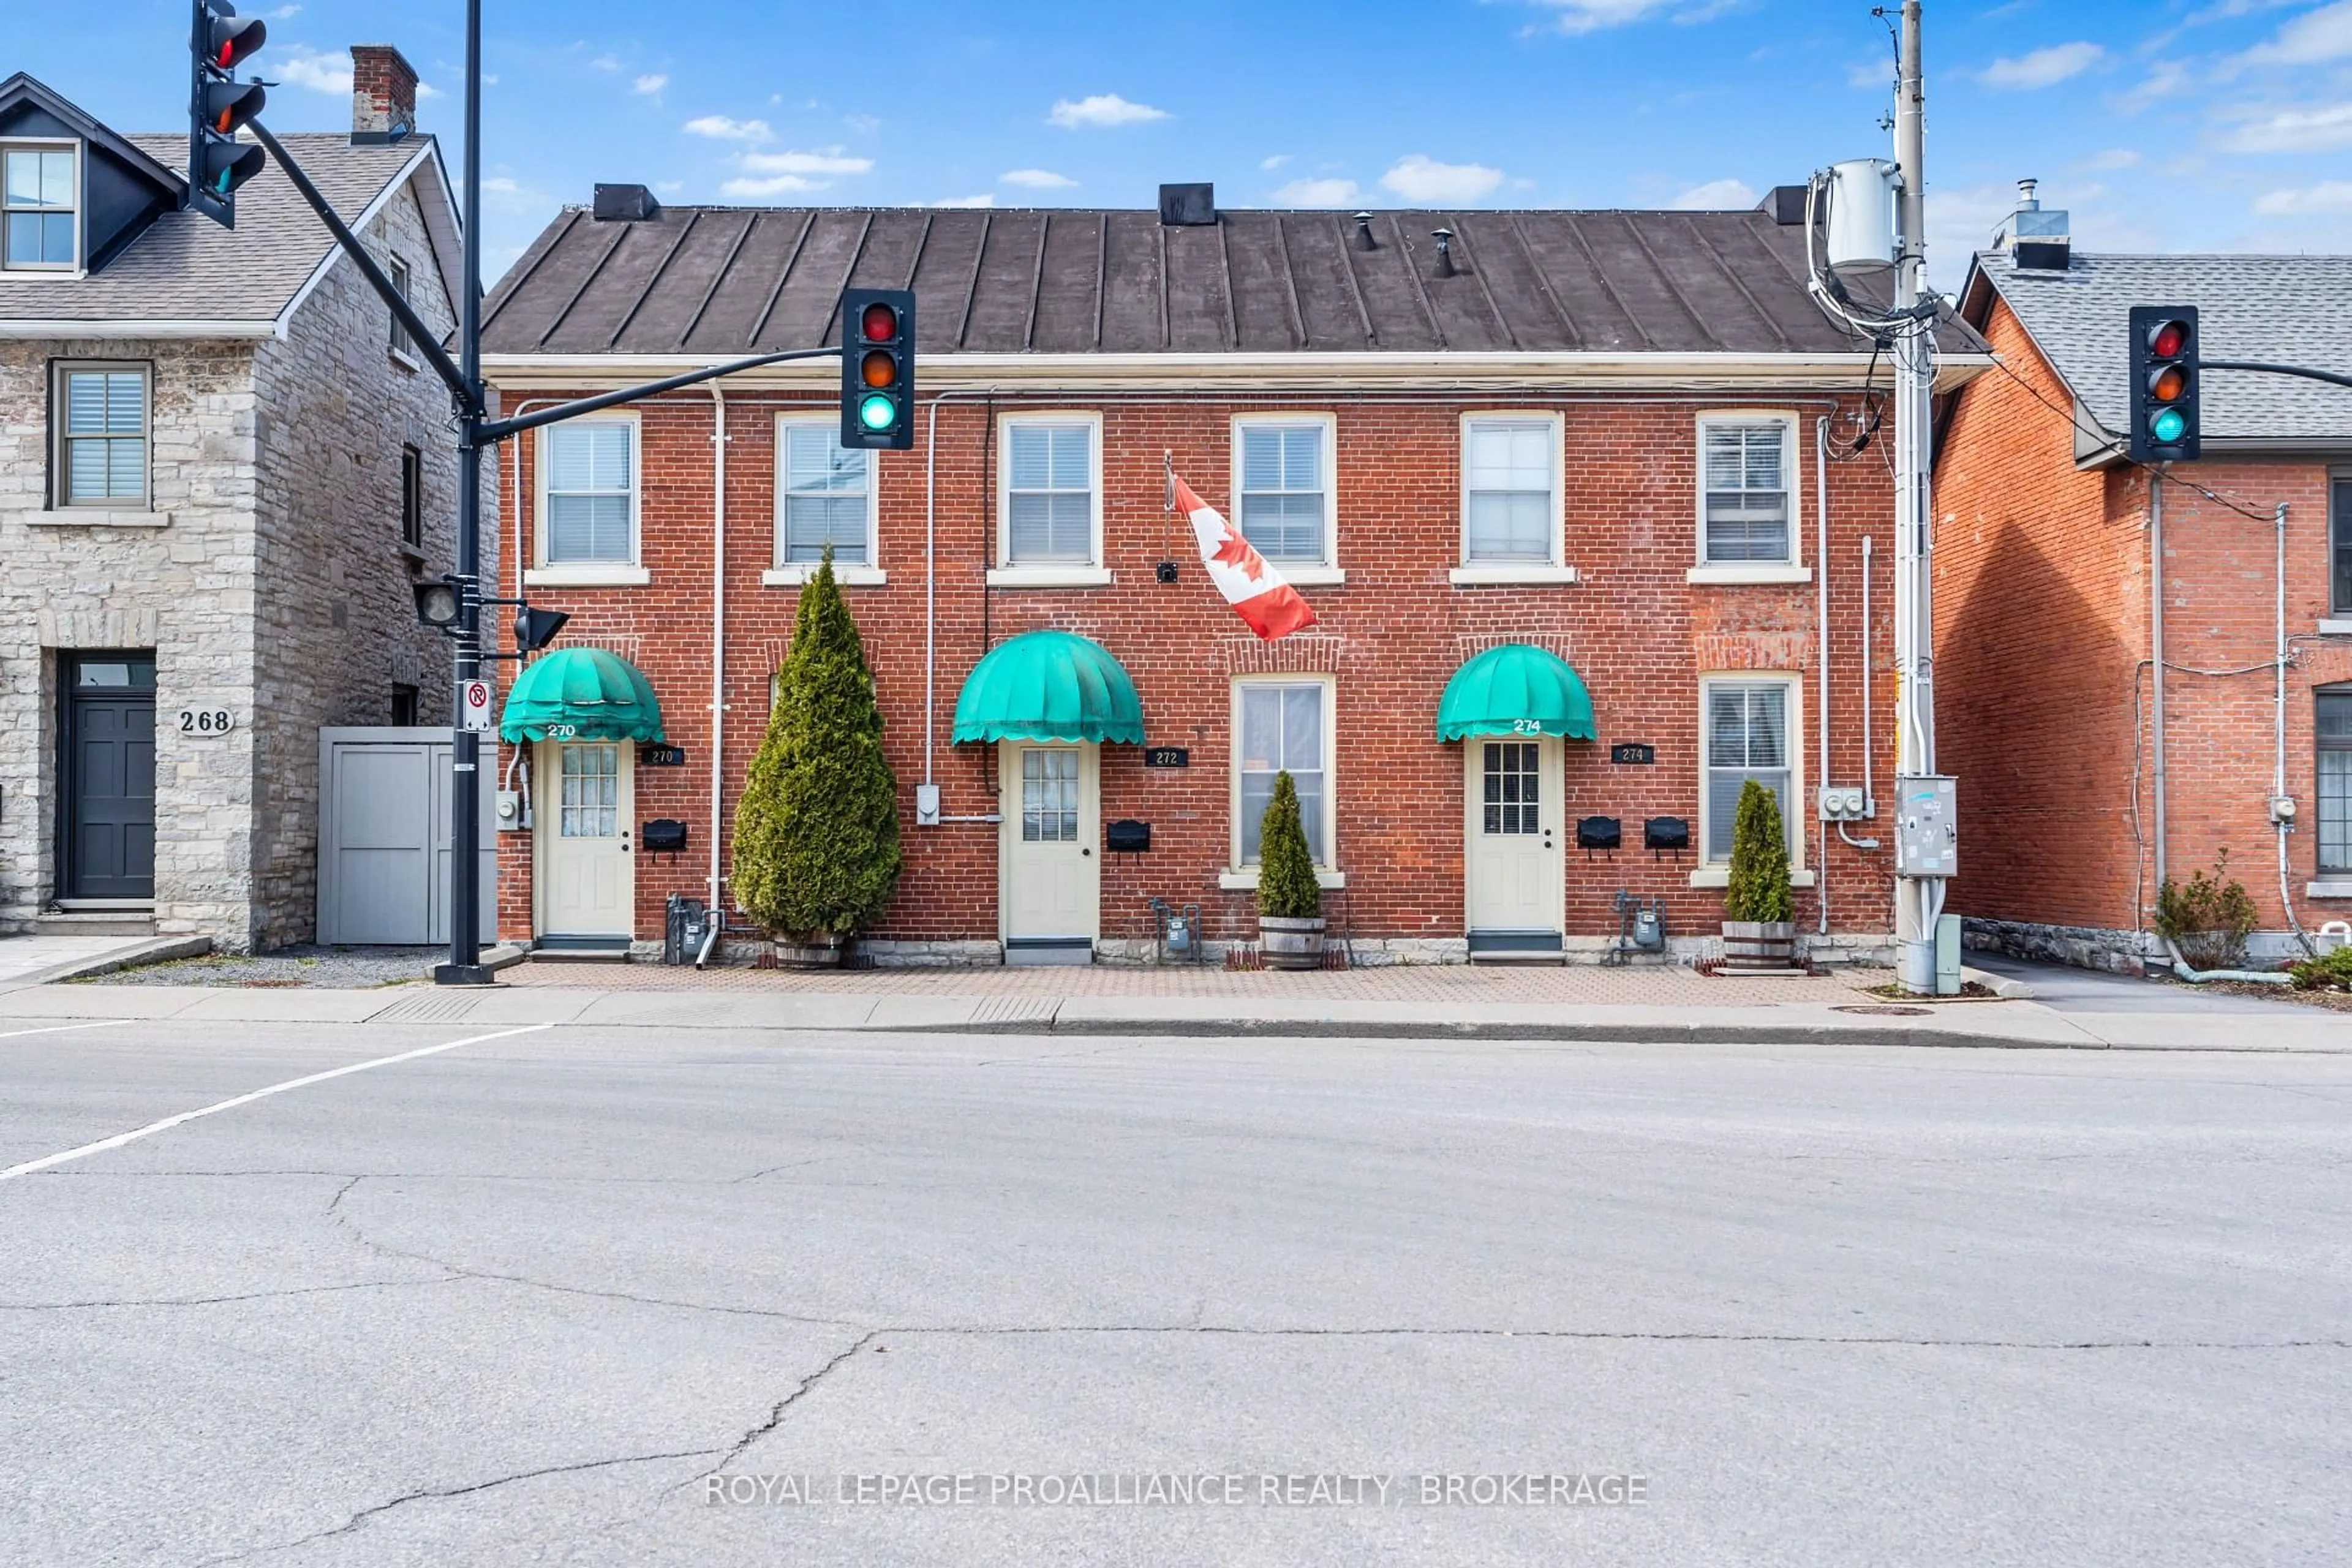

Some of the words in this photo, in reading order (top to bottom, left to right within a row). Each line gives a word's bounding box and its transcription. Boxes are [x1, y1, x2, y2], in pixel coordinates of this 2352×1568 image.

[180, 712, 229, 731] 268
[1513, 719, 1541, 732] 274
[548, 725, 576, 736] 270
[652, 750, 673, 763] 270
[1156, 752, 1177, 764] 272
[1623, 748, 1643, 761] 274
